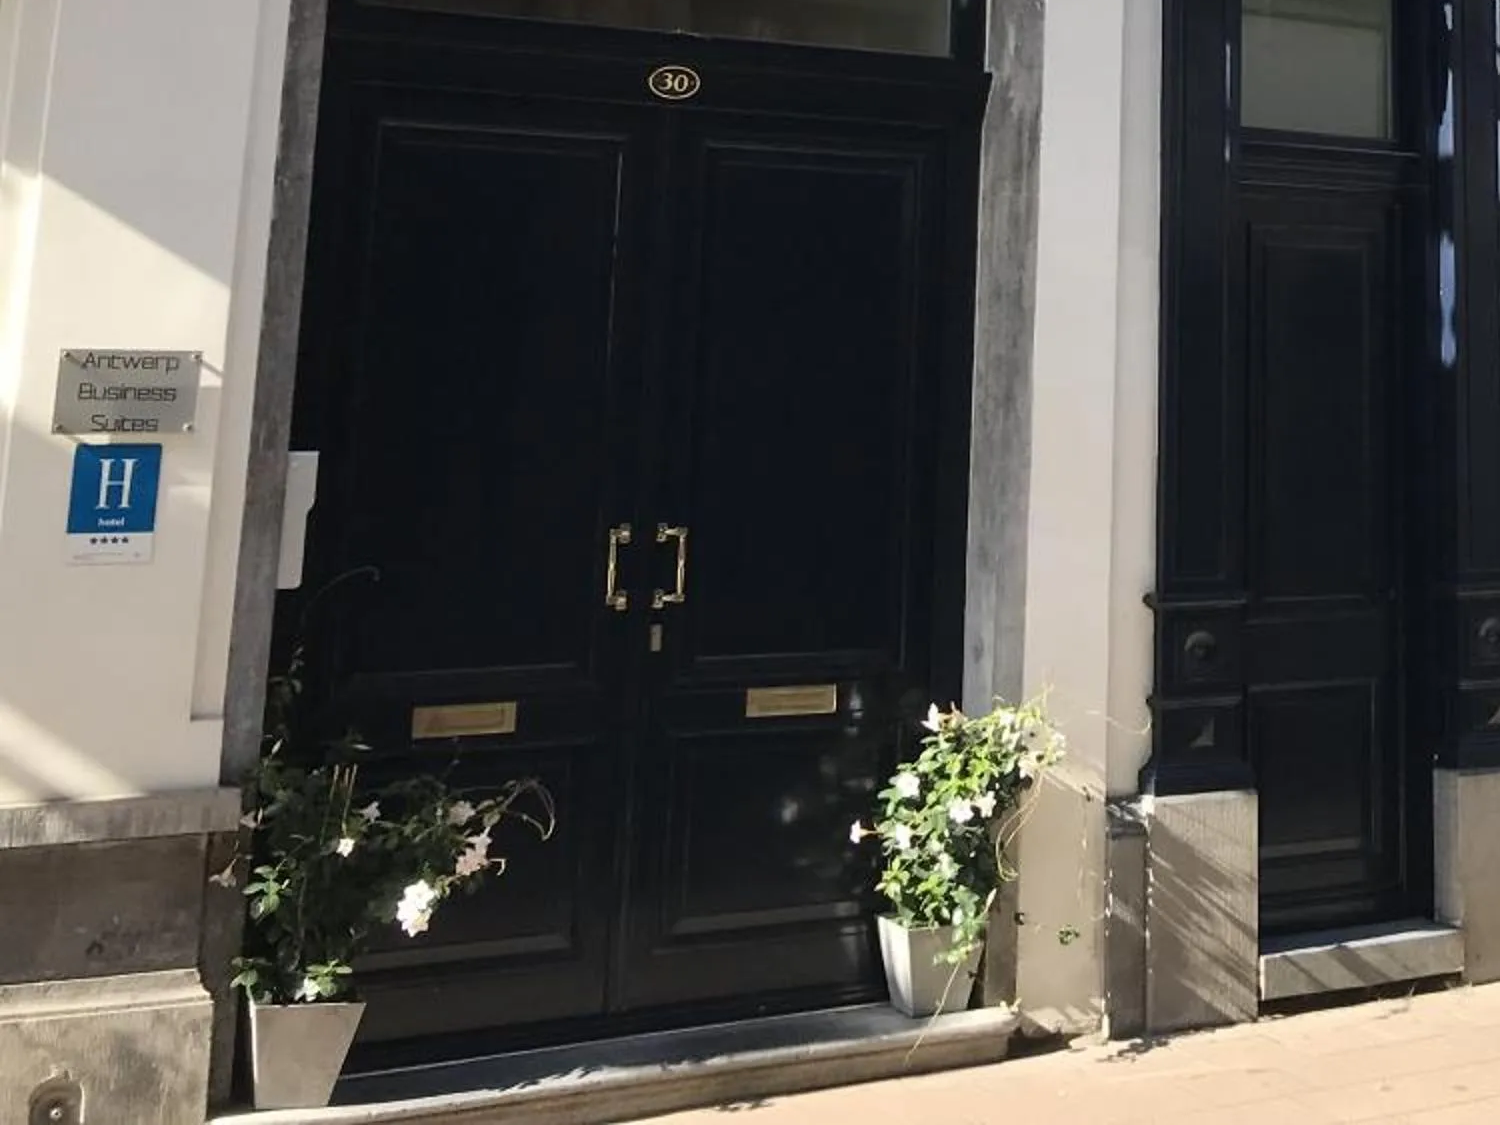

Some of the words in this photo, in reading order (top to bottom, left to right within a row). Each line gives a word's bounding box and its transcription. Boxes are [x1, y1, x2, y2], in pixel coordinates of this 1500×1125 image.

[659, 72, 689, 92] 30
[84, 352, 180, 374] Antwerp
[78, 383, 176, 401] Business
[91, 415, 159, 432] Suites
[96, 458, 138, 509] H
[98, 517, 125, 526] hotel
